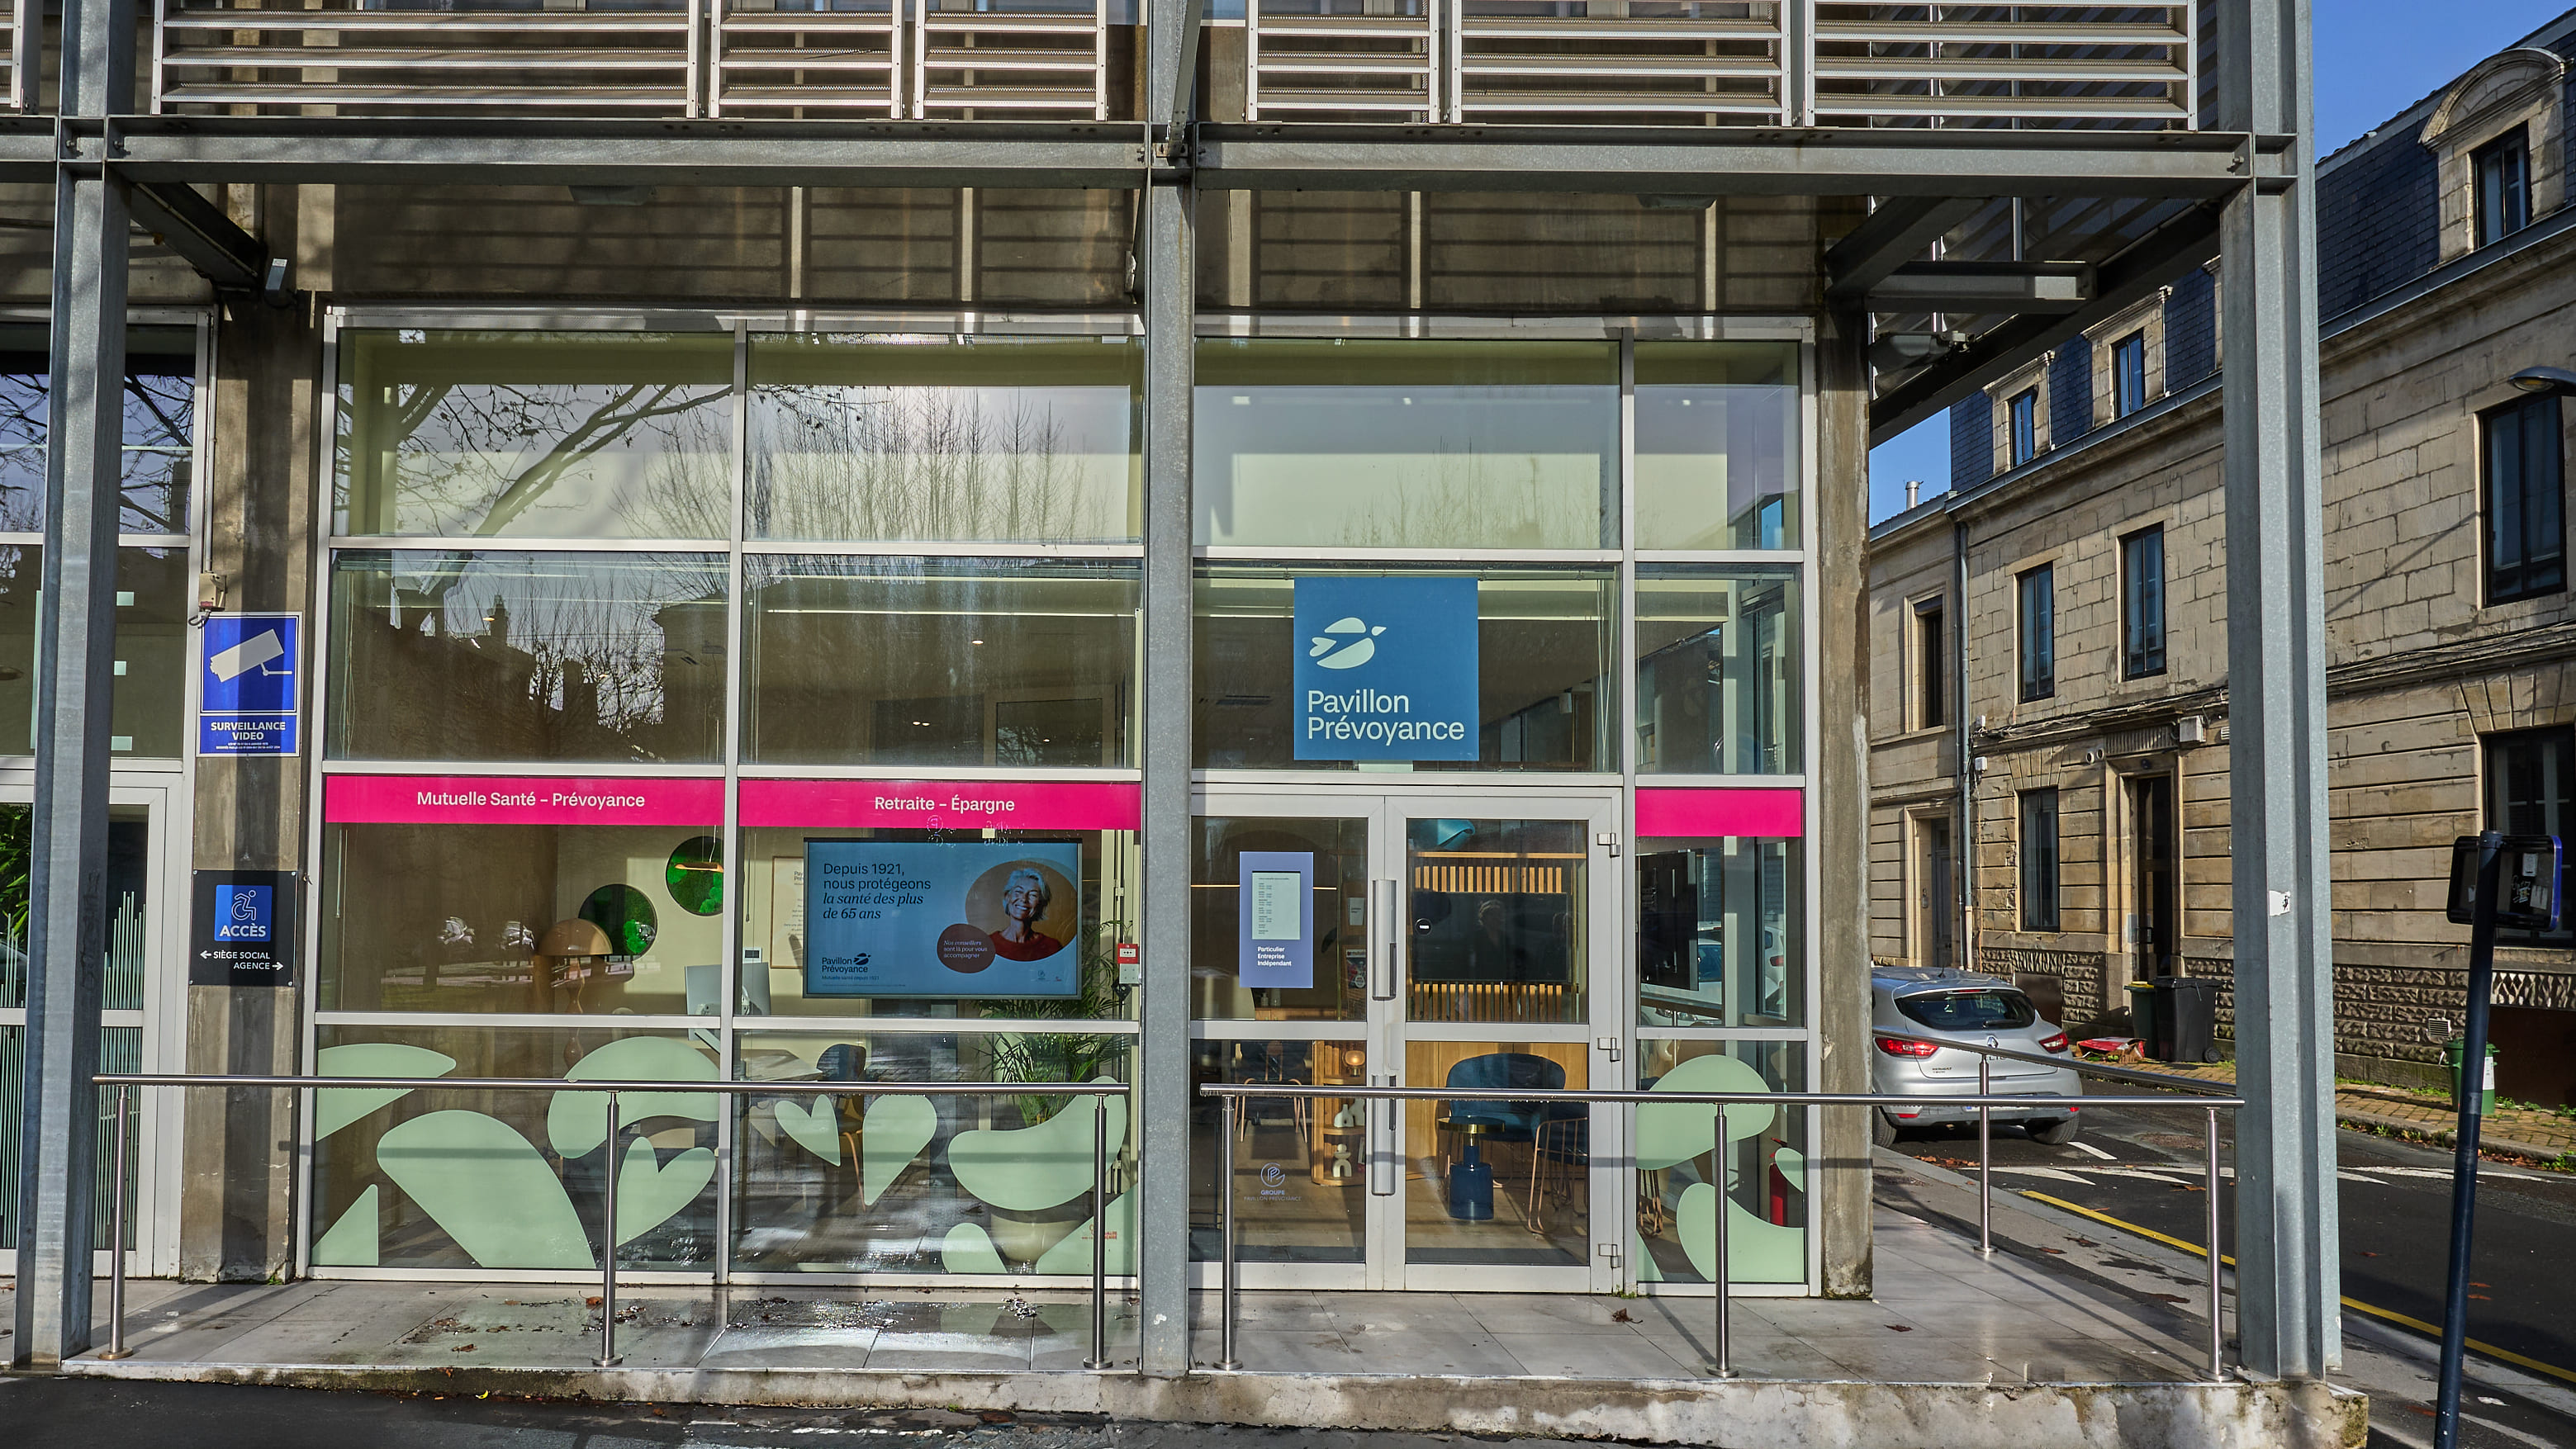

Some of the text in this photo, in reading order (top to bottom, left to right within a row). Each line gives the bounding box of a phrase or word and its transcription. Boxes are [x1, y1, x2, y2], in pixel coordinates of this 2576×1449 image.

[1308, 688, 1409, 713] Pavillon
[211, 721, 286, 732] SURVEILLANCE
[1308, 714, 1465, 746] Prévoyance
[232, 732, 264, 741] VIDEO
[417, 791, 486, 806] Mutuelle
[490, 791, 536, 807] Santé
[553, 793, 645, 810] Prévoyance
[875, 796, 935, 811] Retraite
[951, 794, 1015, 814] Épargne
[823, 863, 904, 877] Depuis 1921,
[823, 878, 932, 893] nous protégeons
[823, 893, 923, 907] la santé des plus
[823, 907, 881, 919] de 65 ans
[219, 922, 266, 937] ACCÈS
[213, 950, 238, 959] SIÈGE
[822, 957, 852, 965] Pavillon
[822, 964, 868, 974] Prévoyance
